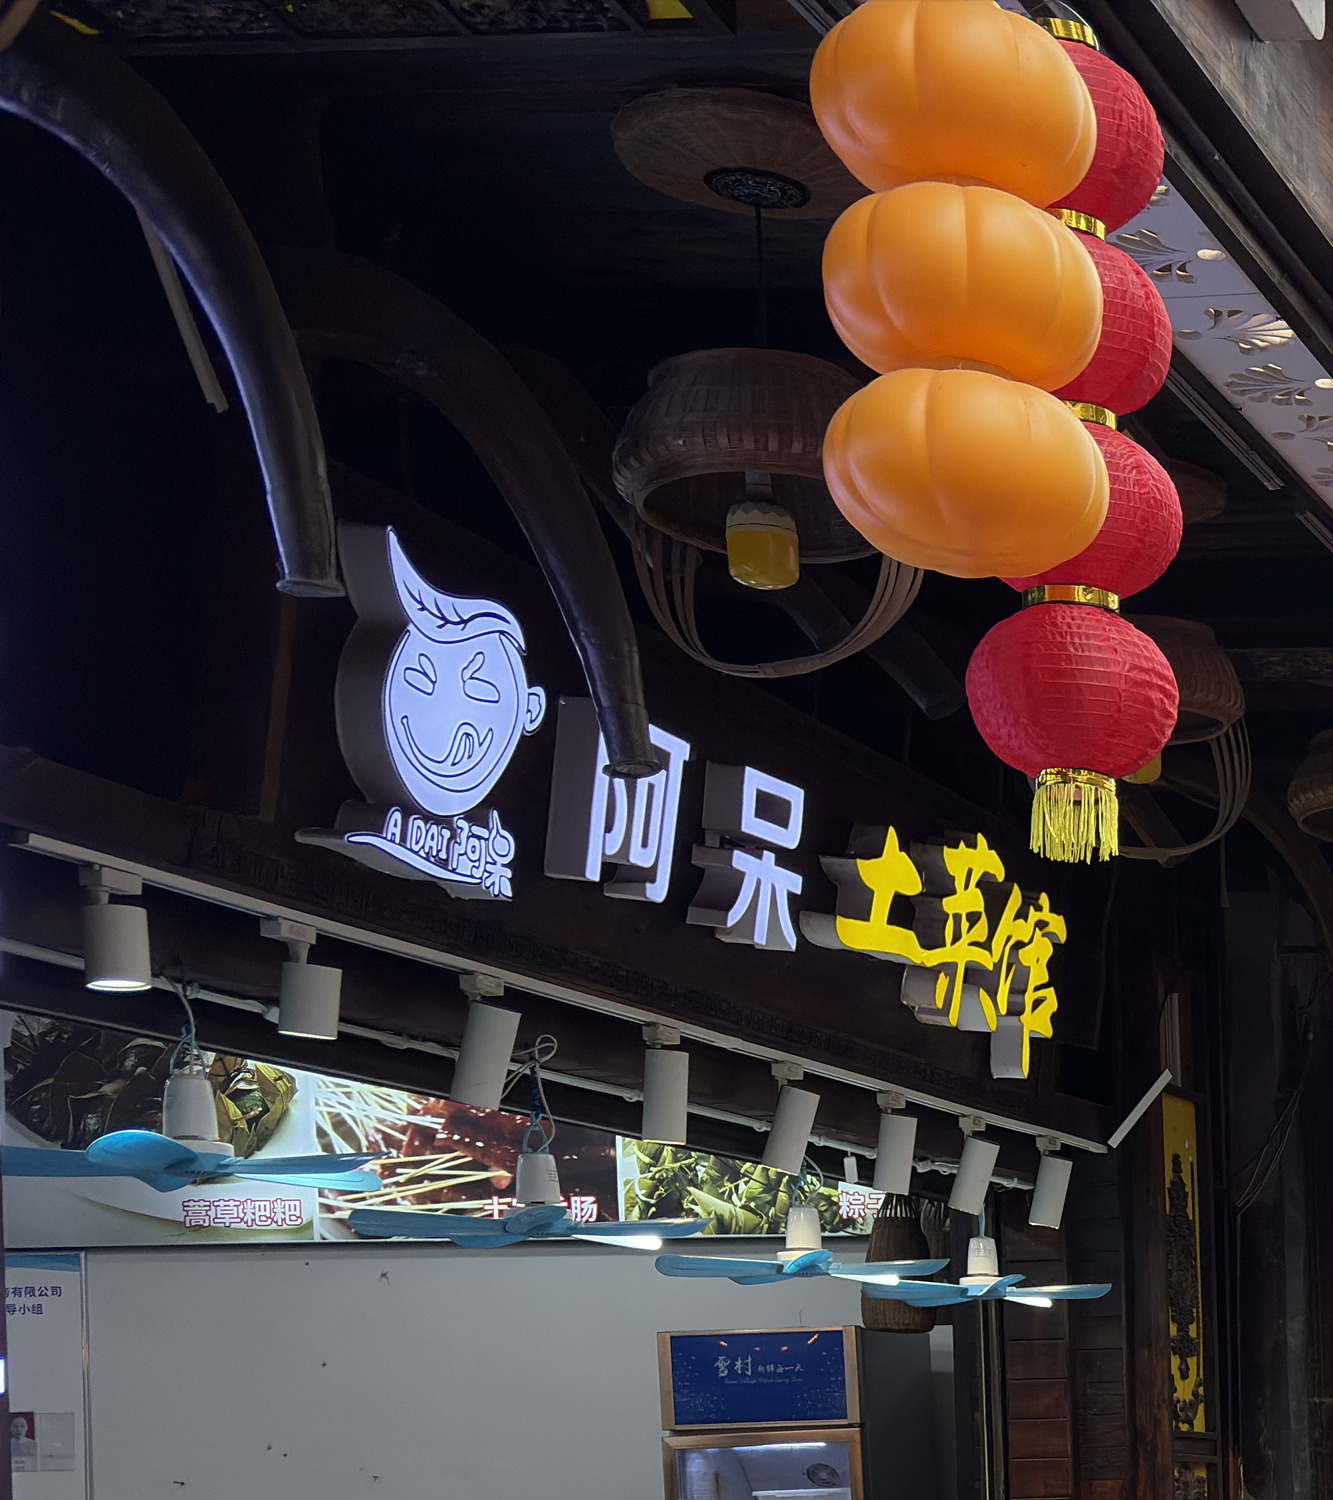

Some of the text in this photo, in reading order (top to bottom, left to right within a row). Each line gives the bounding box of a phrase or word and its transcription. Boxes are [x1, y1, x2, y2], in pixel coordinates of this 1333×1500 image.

[182, 1198, 304, 1228] 蒿草粑粑
[484, 1194, 598, 1223] 土肠
